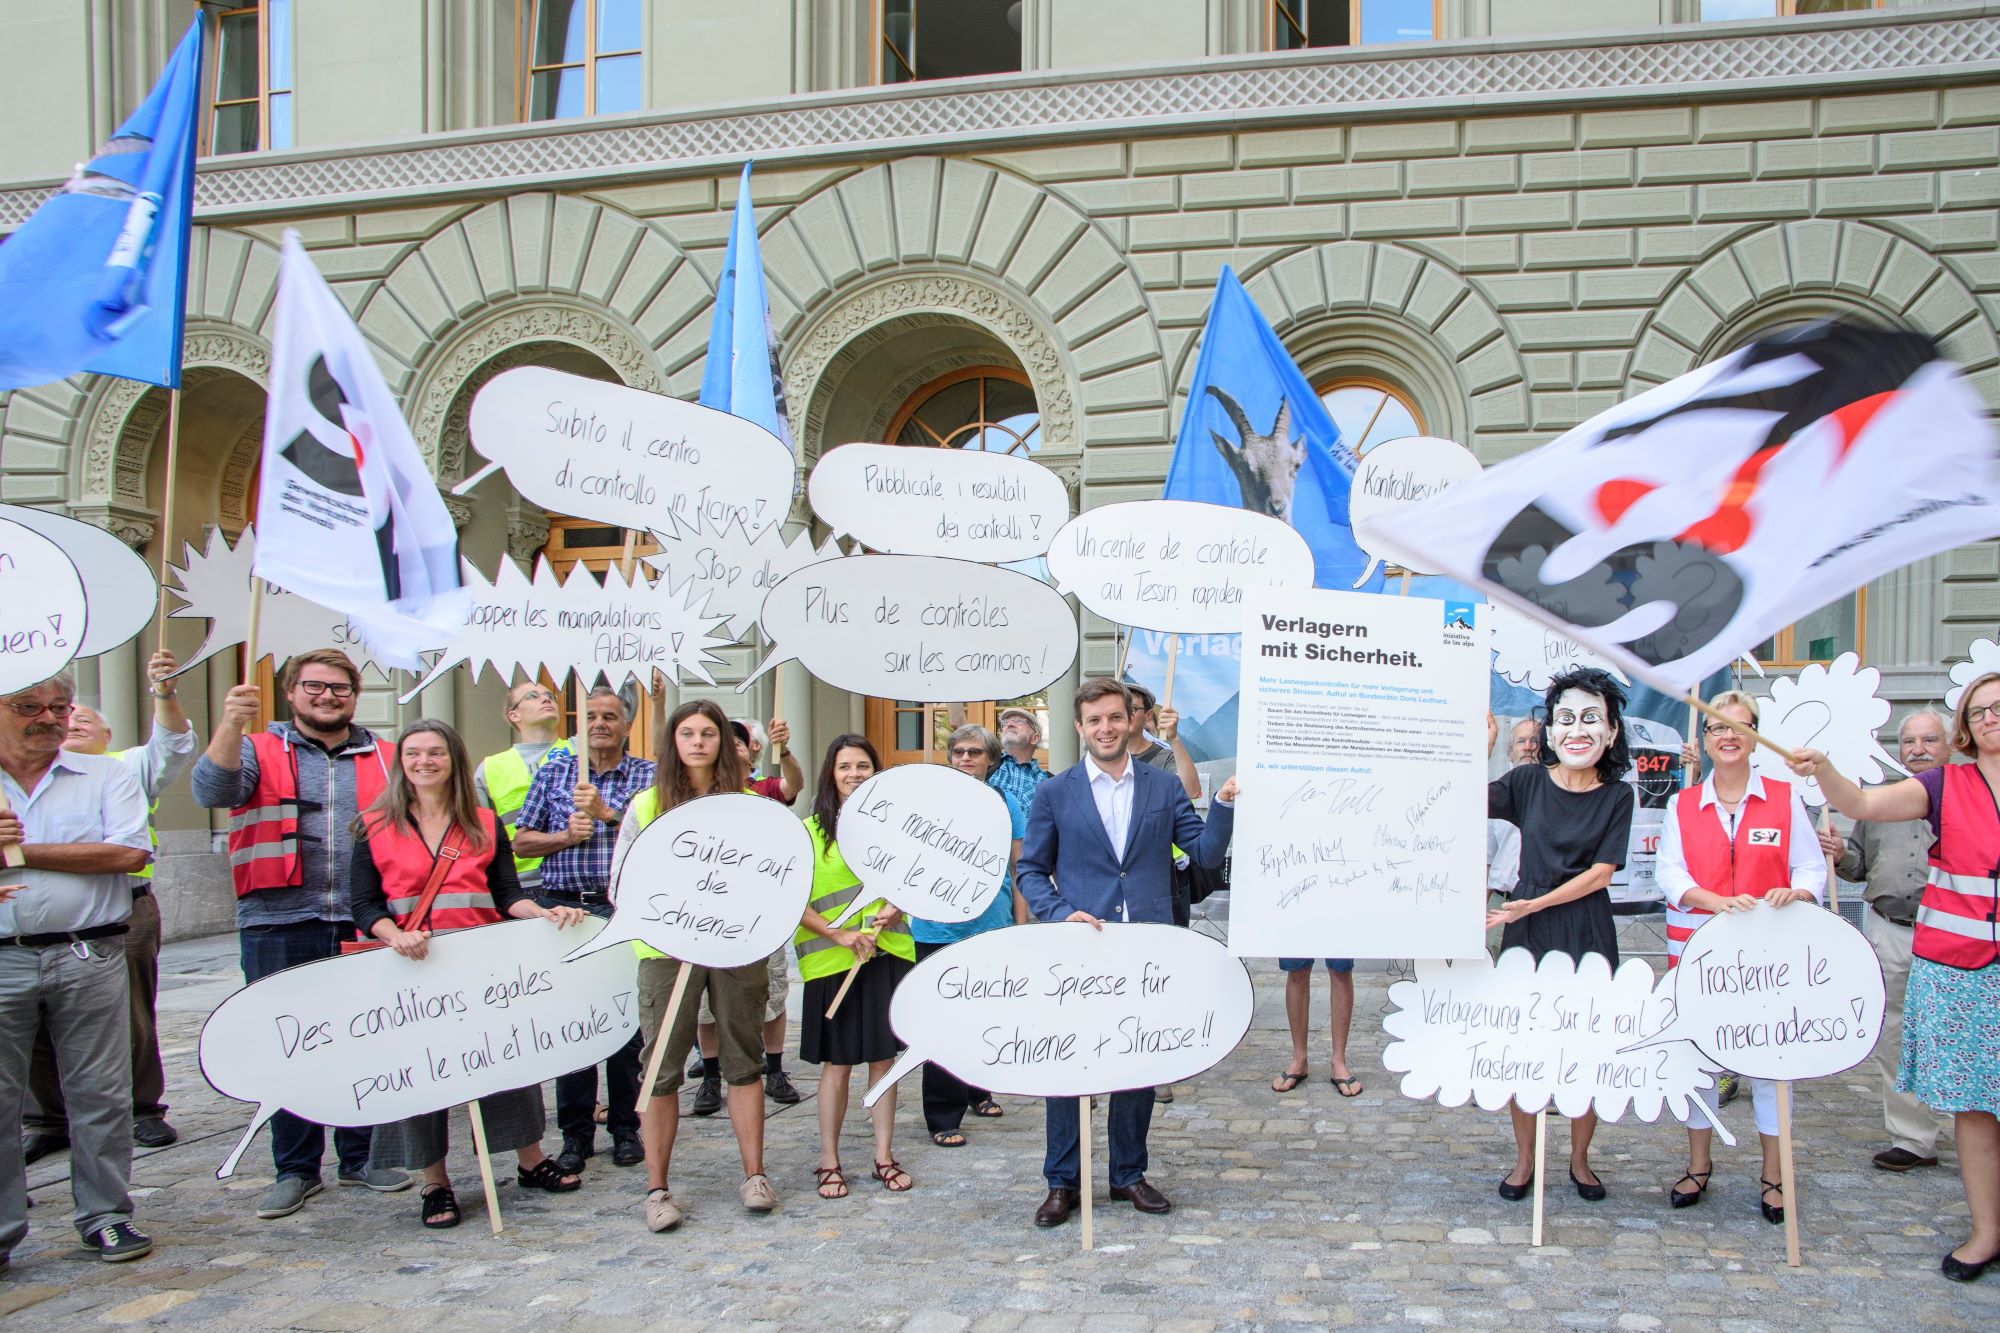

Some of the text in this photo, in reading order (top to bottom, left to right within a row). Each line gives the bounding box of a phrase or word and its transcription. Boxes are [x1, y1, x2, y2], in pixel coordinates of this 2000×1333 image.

[546, 401, 701, 465] Subito il centro
[555, 459, 576, 489] di
[581, 469, 656, 505] controllo
[671, 492, 686, 513] in
[865, 464, 943, 498] Pubblicate
[972, 472, 1027, 502] resultati
[936, 512, 959, 539] dei
[1075, 526, 1268, 565] Un centre de contrôle
[695, 547, 742, 588] Stop
[1100, 582, 1122, 601] au
[1134, 570, 1177, 603] Tessin
[524, 600, 548, 627] les
[558, 602, 662, 634] manipulations
[806, 586, 1009, 628] Plus de contrôles
[1261, 613, 1368, 639] Verlagern
[1261, 642, 1423, 668] mit Sicherheit.
[1443, 632, 1470, 641] iniziativa
[1452, 639, 1461, 647] las
[1462, 640, 1475, 649] alps
[1544, 628, 1580, 666] faire
[884, 651, 911, 673] sur
[919, 641, 945, 674] les
[1259, 676, 1277, 684] Mehr
[1279, 678, 1349, 689] Lastwagenkontrollen
[1351, 681, 1360, 689] für
[1380, 684, 1419, 695] Verlagerung
[1259, 686, 1291, 694] sicherere
[1292, 688, 1324, 697] Strassen.
[1326, 690, 1346, 698] Aufruf
[1359, 691, 1398, 701] Bundesrätin
[1399, 694, 1416, 702] Doris
[1418, 696, 1449, 704] Leuthard.
[1256, 762, 1266, 770] Ja,
[1280, 763, 1324, 771] unterstützen
[1636, 755, 1670, 772] 847
[857, 780, 894, 823] Les
[671, 830, 796, 886] Güter auf
[901, 812, 1006, 877] marchandises
[696, 869, 728, 895] die
[863, 845, 897, 874] sur
[903, 853, 925, 887] le
[640, 893, 762, 942] Schiene!
[937, 961, 1172, 1006] Gleiche Spiesse für
[1691, 945, 1831, 995] Trasferire le
[275, 1014, 333, 1059] Des
[349, 985, 468, 1039] conditions
[1551, 994, 1580, 1032] Sur
[1588, 996, 1601, 1033] le
[981, 1026, 1078, 1066] Schiene
[1118, 1009, 1215, 1055] Strasse!!
[1716, 1023, 1769, 1051] merci
[352, 1066, 414, 1111] pour
[427, 1047, 452, 1083] le
[462, 1031, 496, 1074] rail
[503, 1025, 522, 1061] et
[531, 1017, 554, 1055] la
[1466, 1040, 1545, 1082] Trasferire
[1557, 1047, 1578, 1086] le
